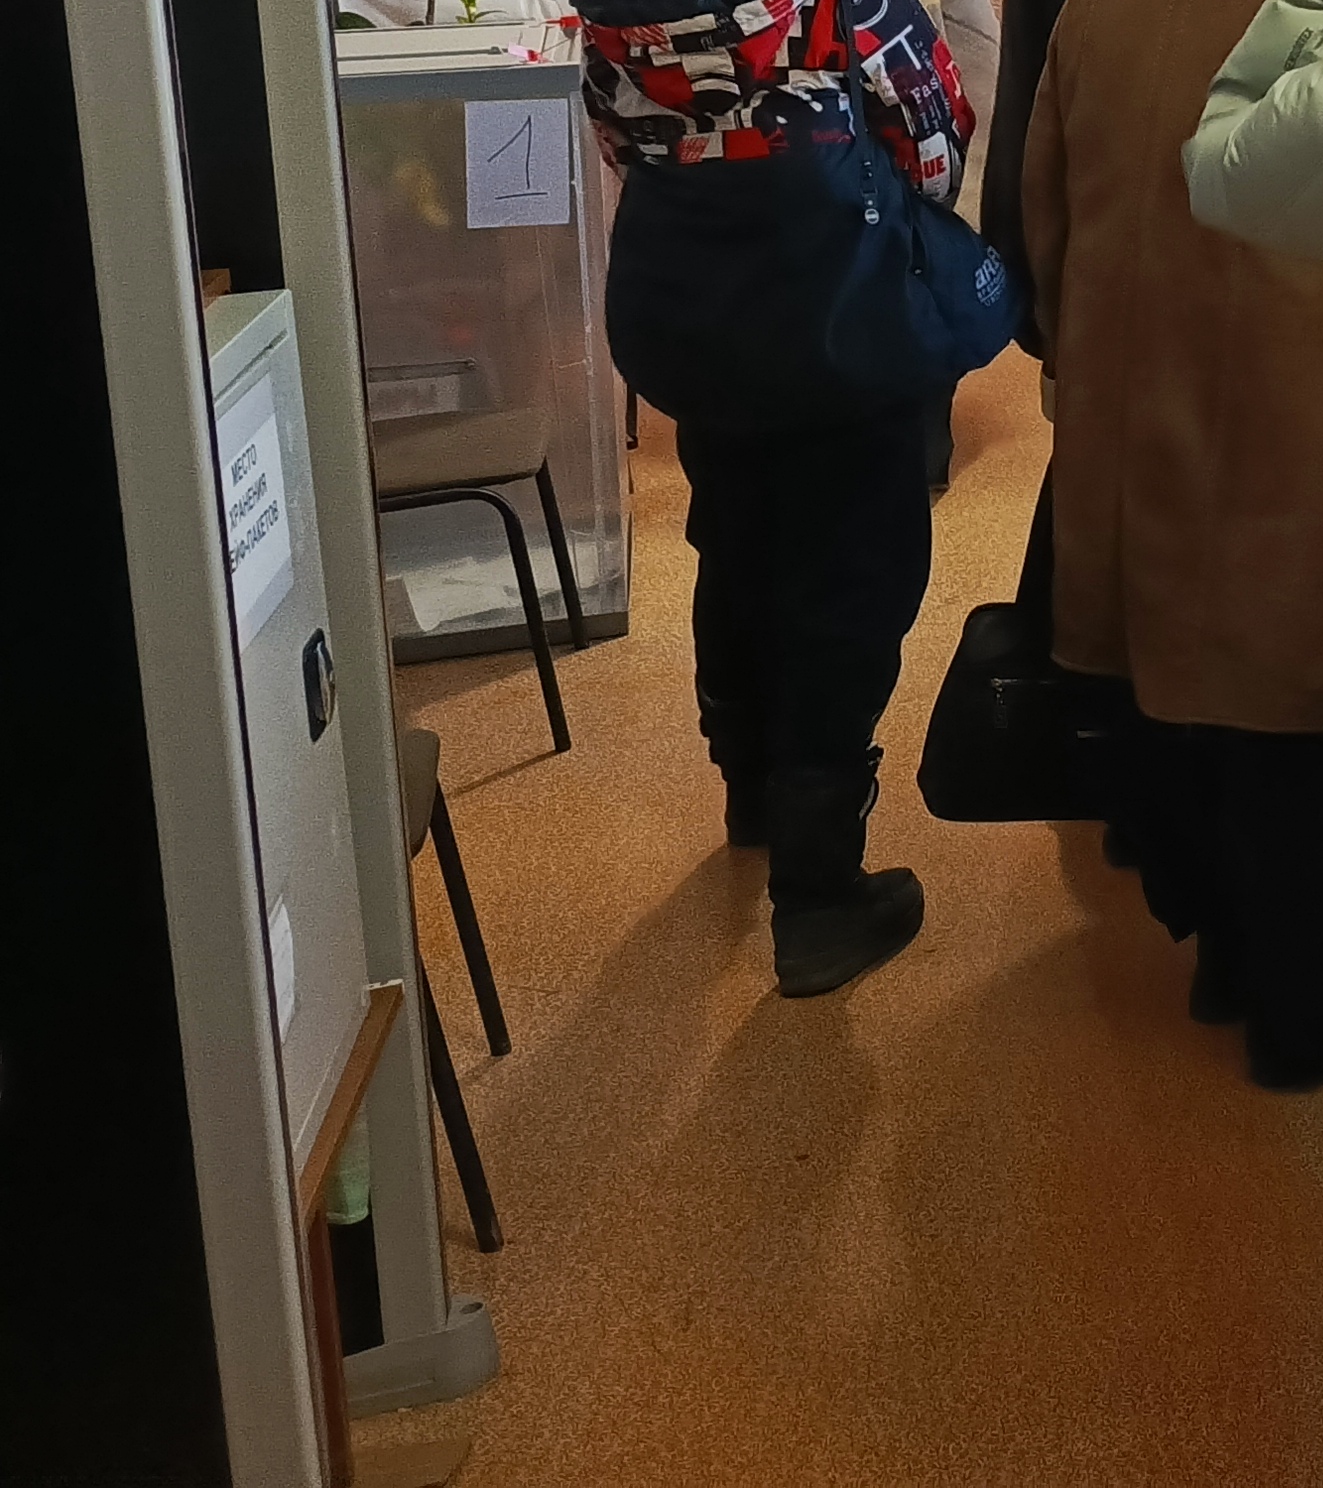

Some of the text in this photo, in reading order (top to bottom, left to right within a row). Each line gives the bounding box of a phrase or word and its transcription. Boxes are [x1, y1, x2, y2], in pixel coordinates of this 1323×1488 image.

[487, 115, 541, 197] 1
[231, 443, 257, 487] МЕСТО
[229, 472, 268, 532] ХРАНЕНИЯ
[228, 499, 279, 574] ЕЙФ-ПАКЕТОВ
